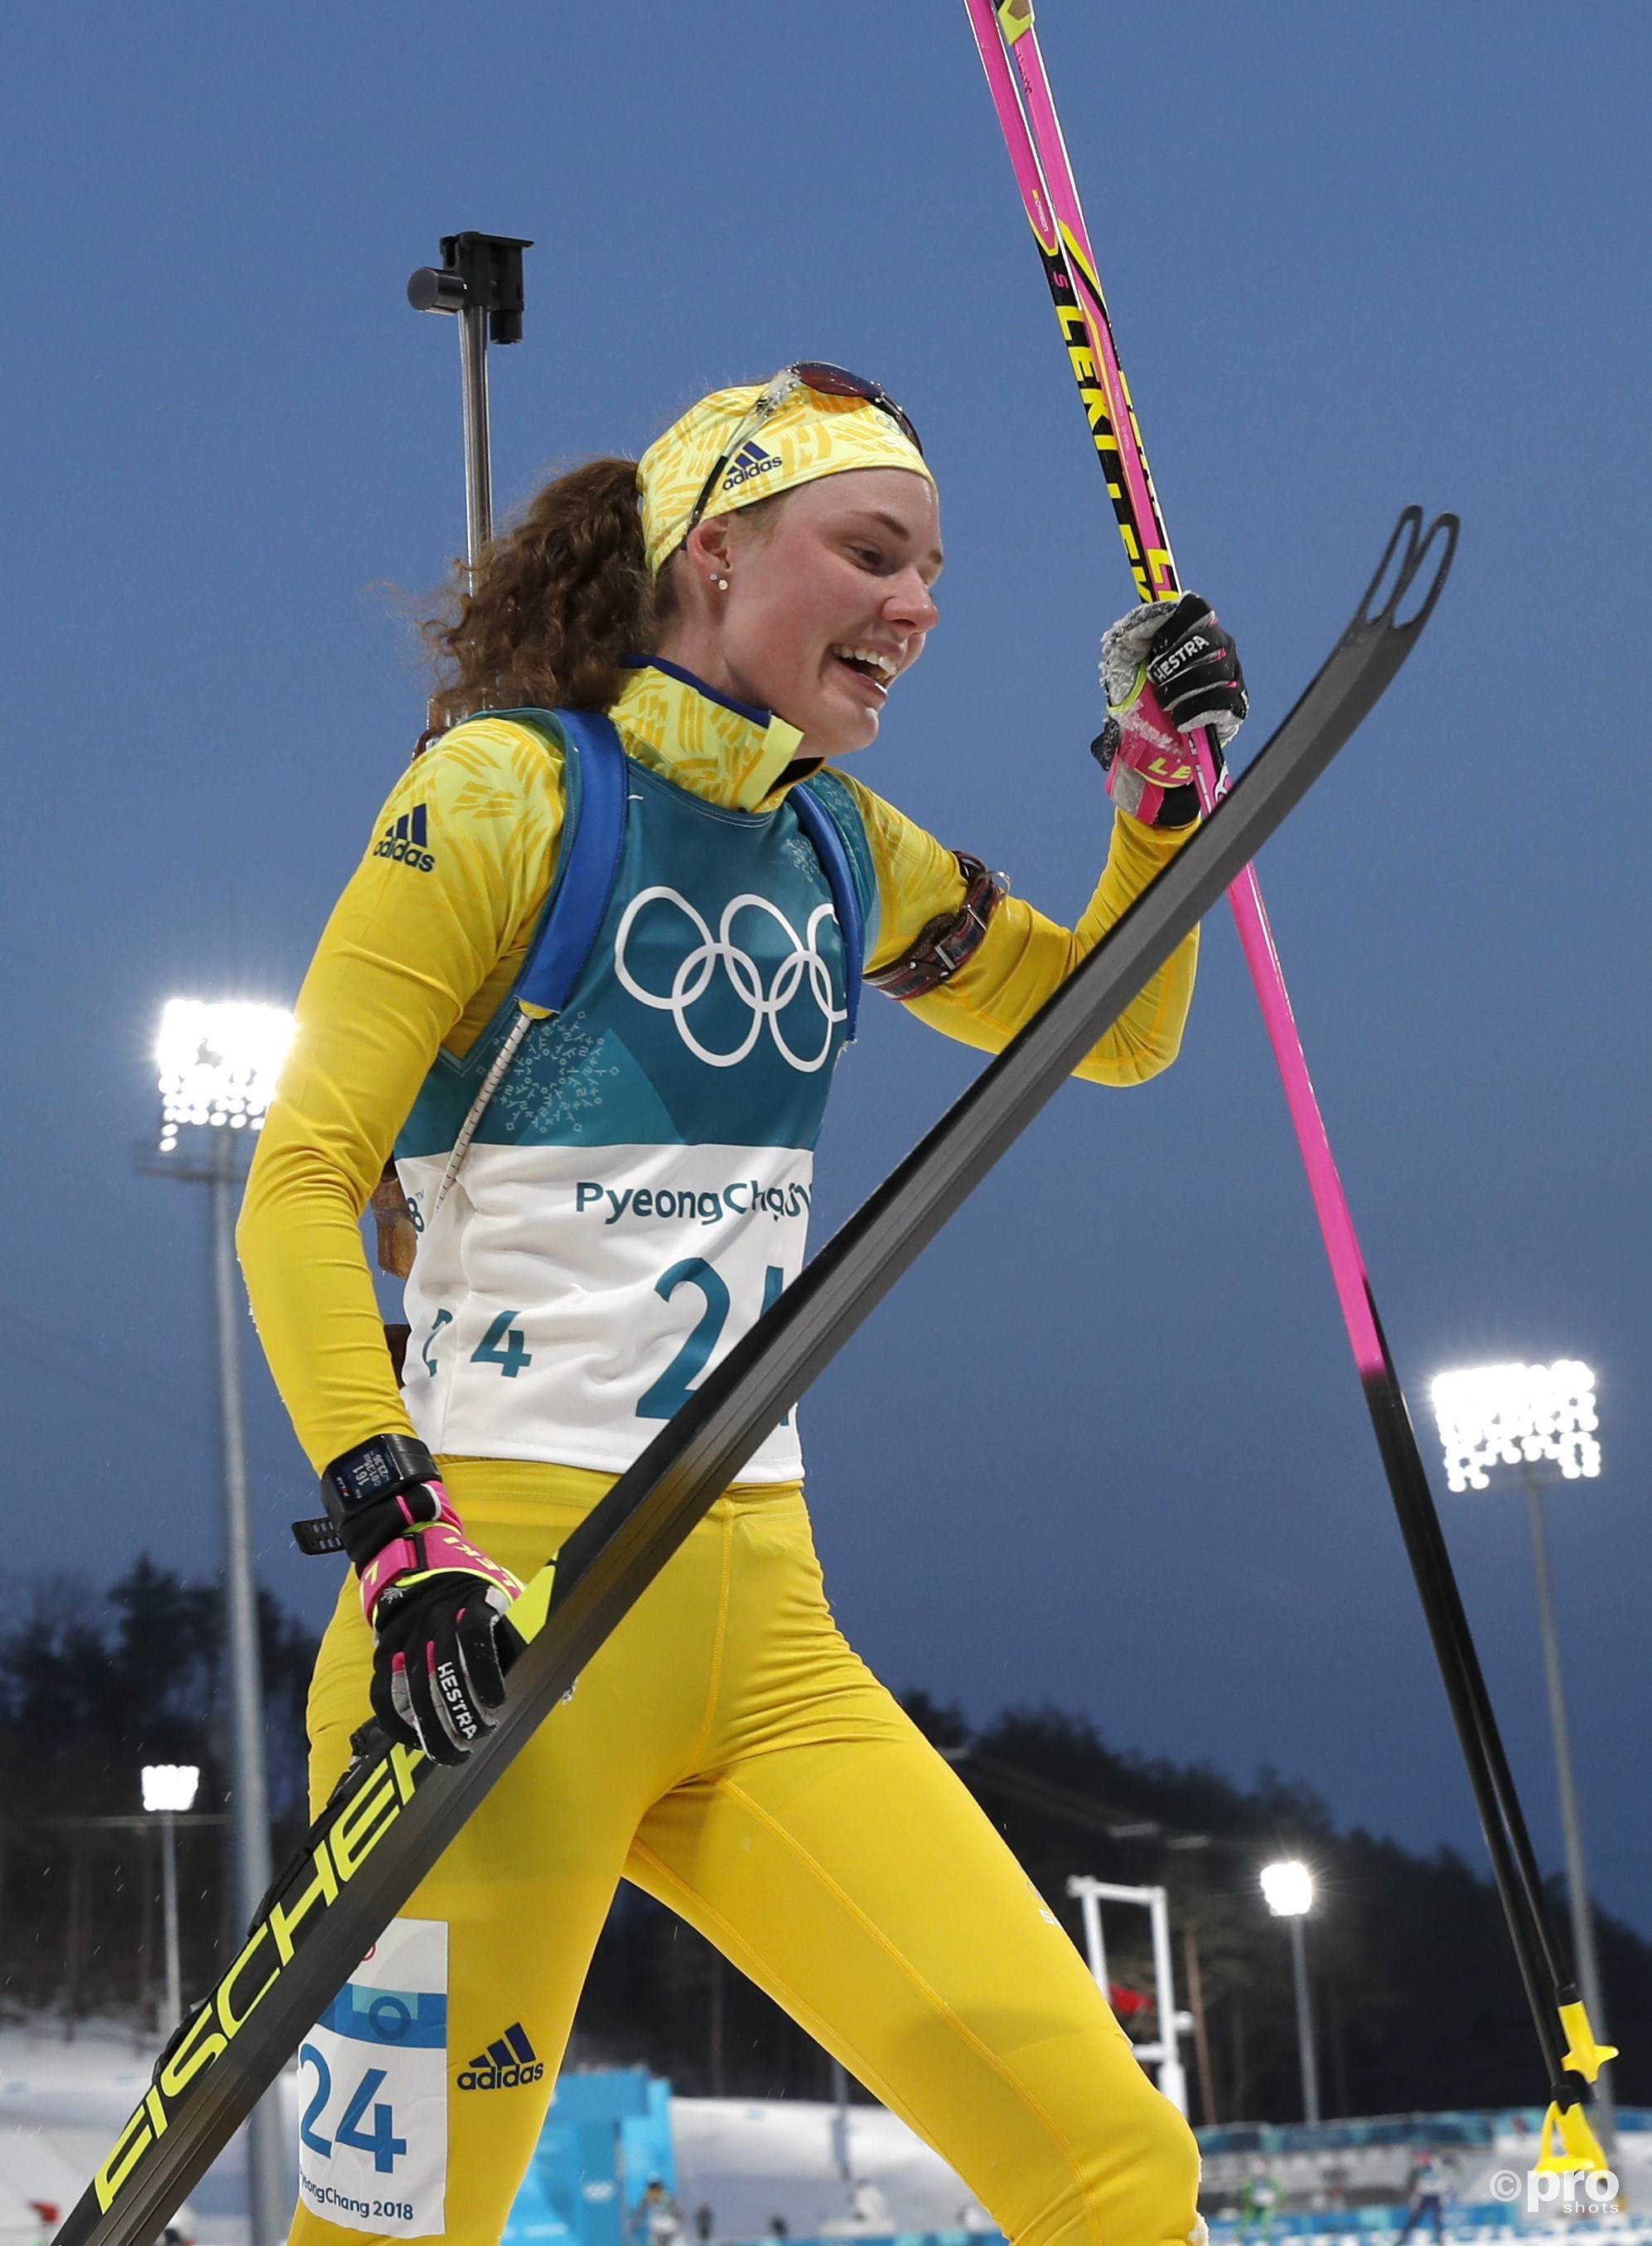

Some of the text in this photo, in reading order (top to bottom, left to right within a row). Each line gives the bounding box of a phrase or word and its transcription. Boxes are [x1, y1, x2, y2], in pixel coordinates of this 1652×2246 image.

[1055, 305, 1118, 451] LEKI
[722, 456, 782, 491] adidas
[1154, 635, 1210, 682] HESTRA
[374, 837, 436, 872] adidas
[635, 1257, 789, 1427] 2
[437, 1661, 478, 1741] HESTRA
[457, 2062, 543, 2090] adidas
[299, 2043, 407, 2174] 24
[373, 2200, 413, 2220] 2018
